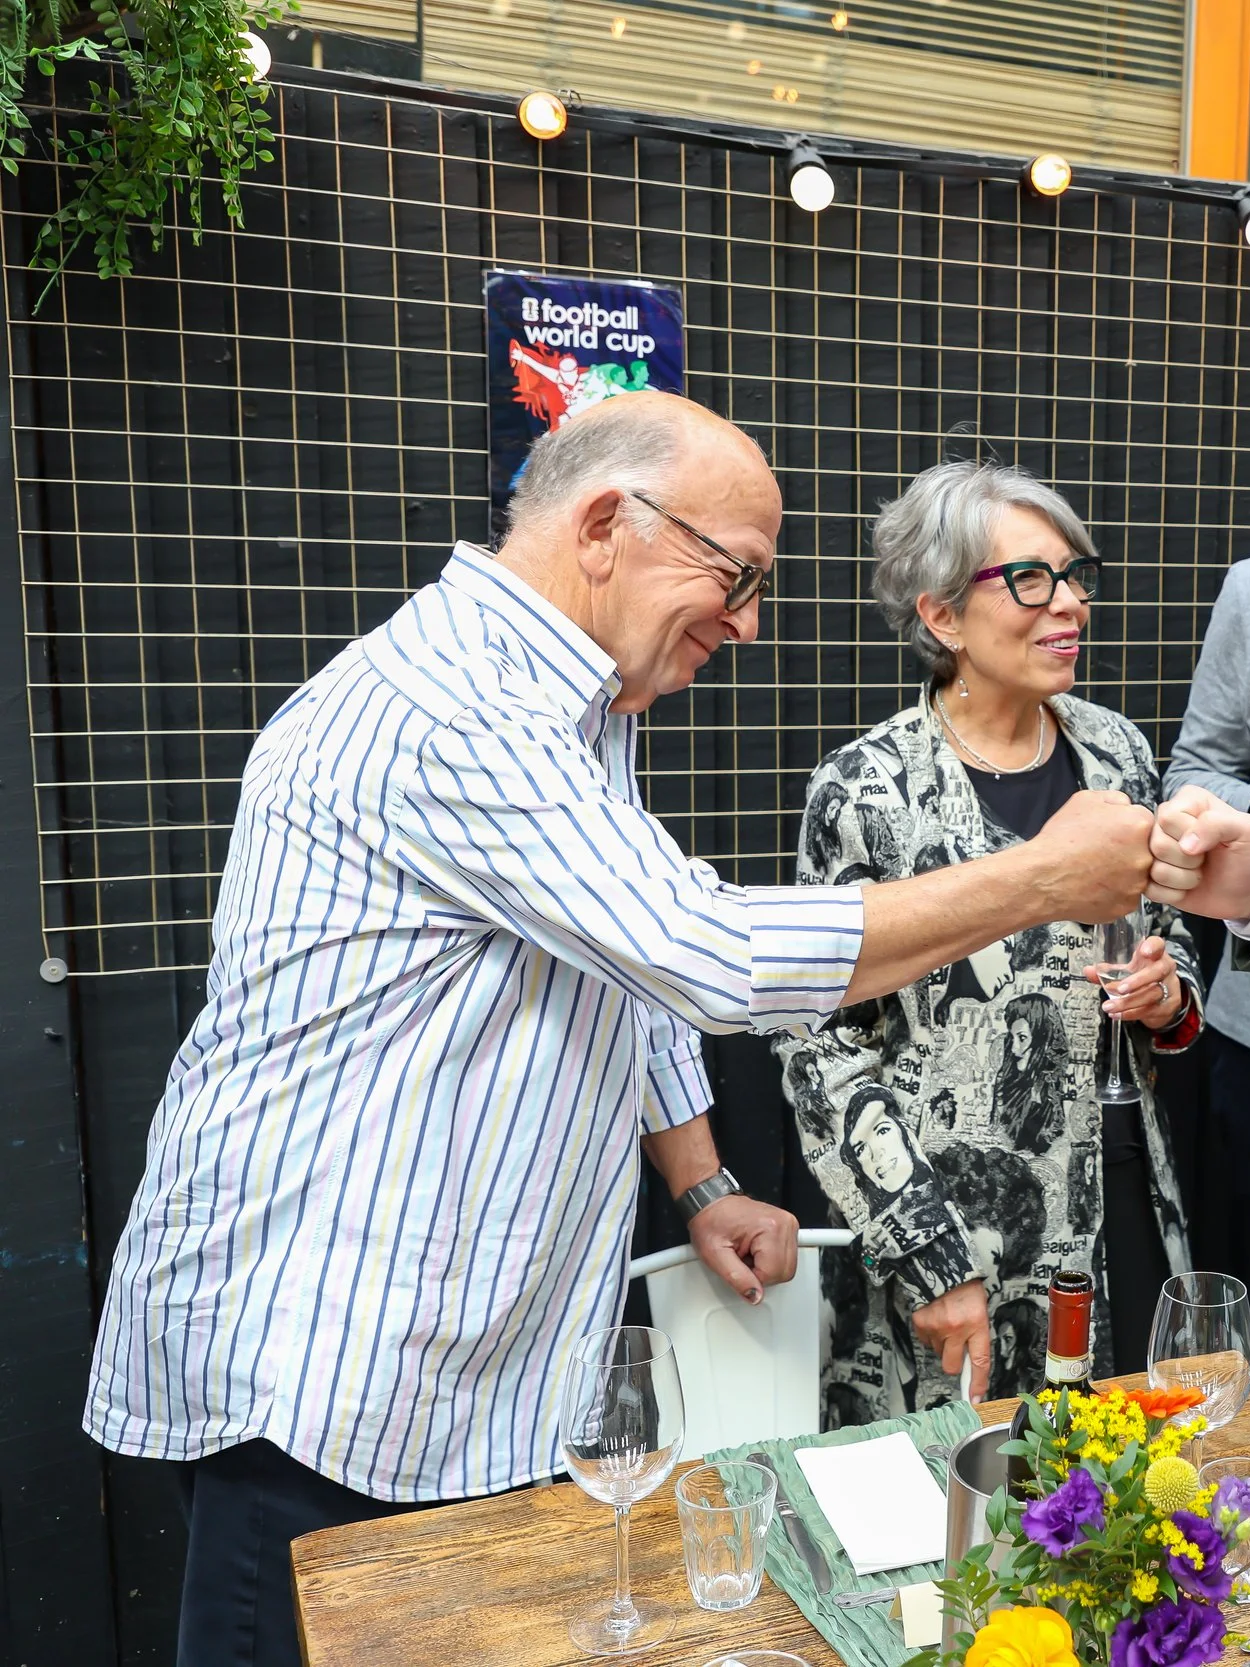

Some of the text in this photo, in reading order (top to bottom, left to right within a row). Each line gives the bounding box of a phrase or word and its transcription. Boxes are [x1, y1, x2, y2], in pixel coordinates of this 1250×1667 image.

[541, 298, 639, 330] football
[524, 325, 655, 358] world cup
[1045, 951, 1069, 972] and
[1042, 1236, 1087, 1256] esigual
